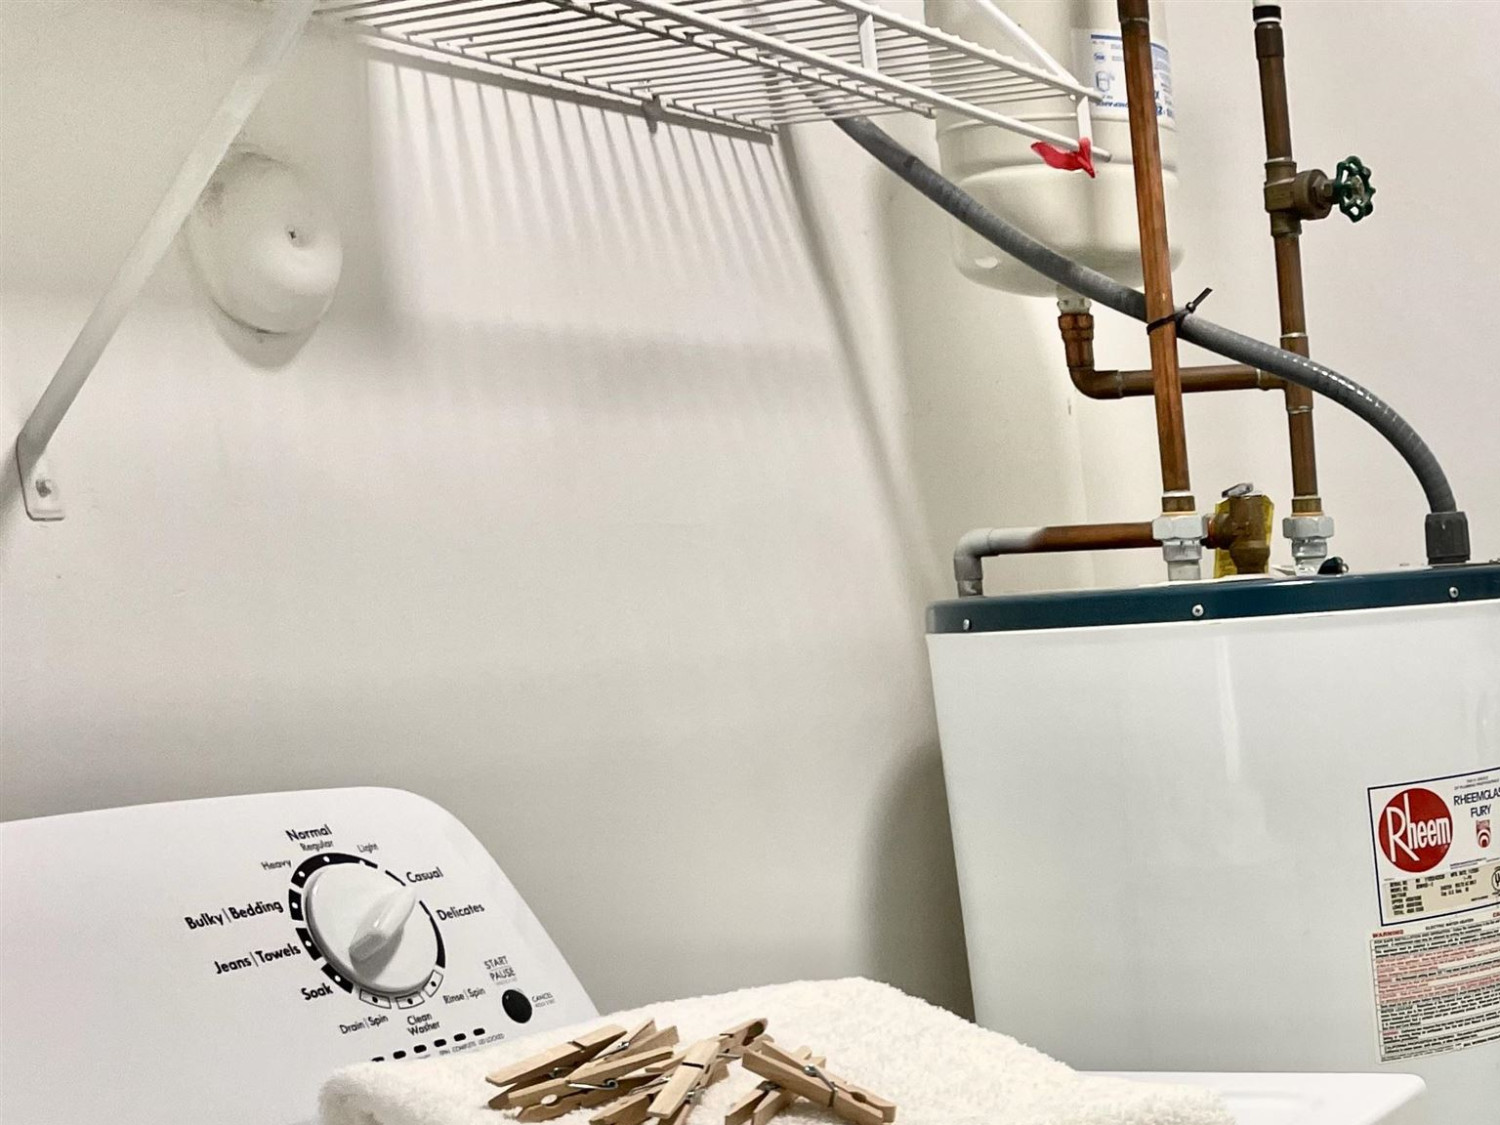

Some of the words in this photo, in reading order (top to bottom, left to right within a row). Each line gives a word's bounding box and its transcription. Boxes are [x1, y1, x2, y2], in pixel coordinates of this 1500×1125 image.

[1470, 804, 1492, 818] FURY
[285, 824, 333, 841] Normal
[1386, 792, 1451, 863] Rheem
[300, 840, 334, 852] Regular
[357, 841, 379, 854] Light
[261, 859, 292, 870] Heavy
[406, 866, 444, 883] Casual
[436, 903, 485, 921] Delicates
[484, 955, 508, 970] START
[490, 967, 516, 981] PAUSE
[301, 982, 334, 1001] Soak
[407, 1012, 432, 1026] Clean
[407, 1020, 440, 1036] Washer
